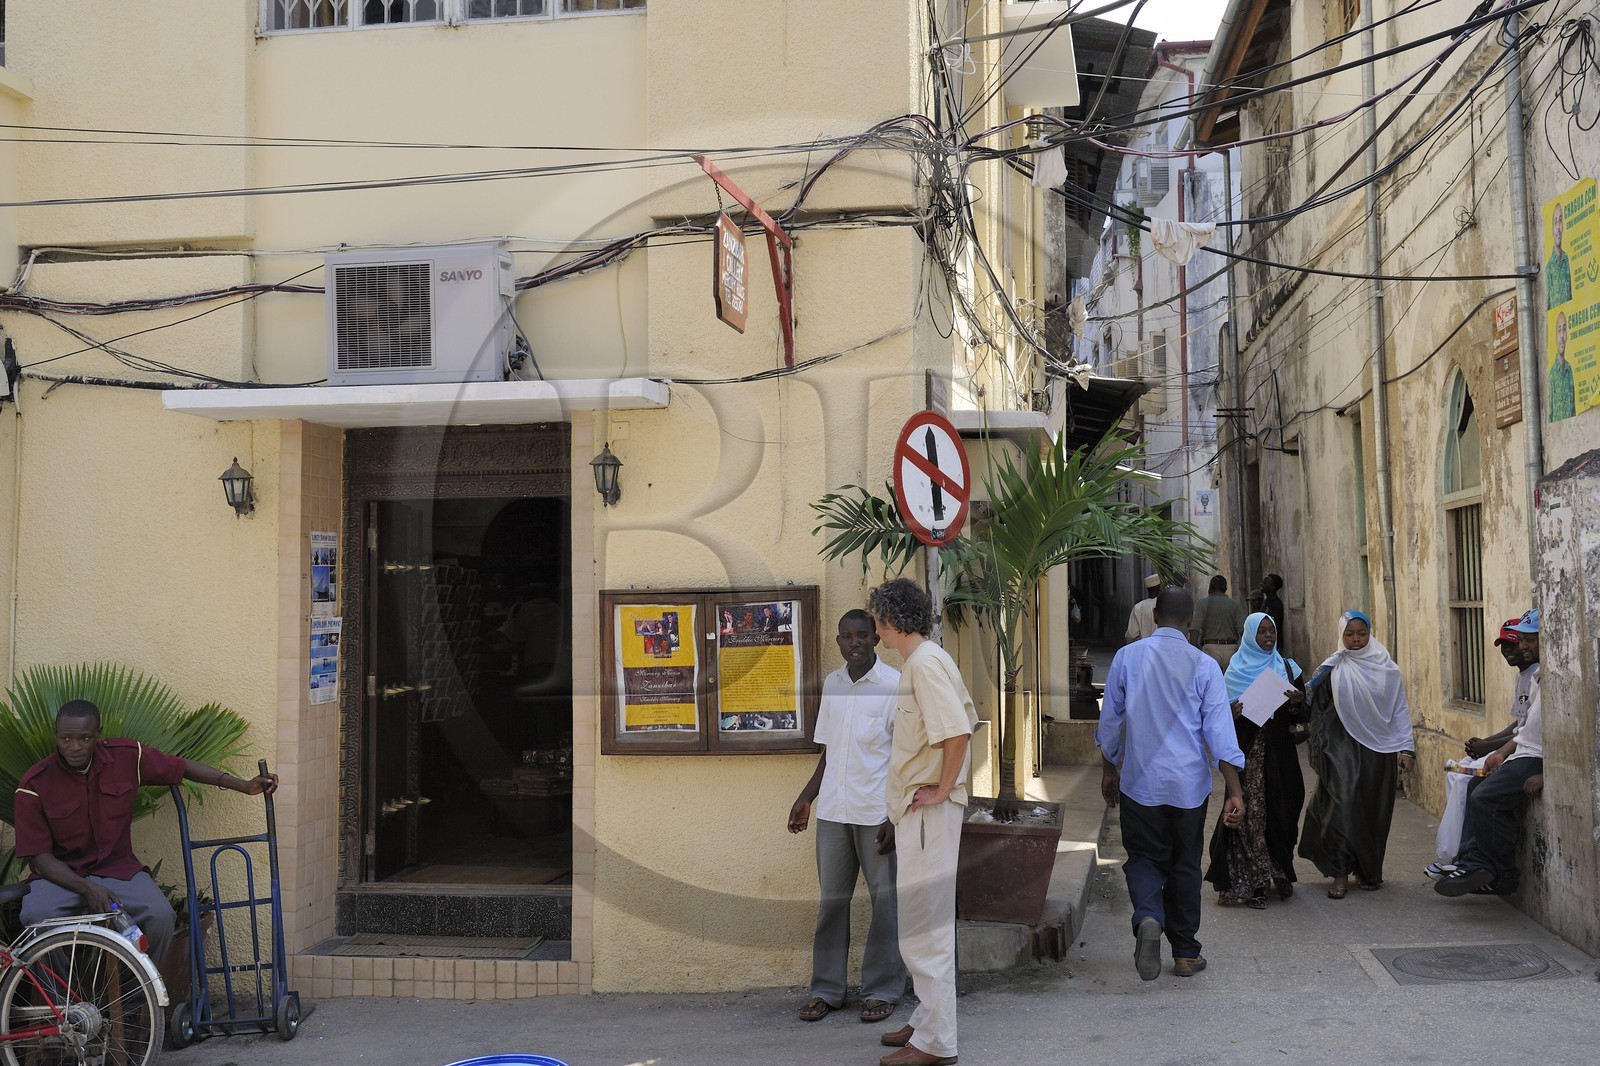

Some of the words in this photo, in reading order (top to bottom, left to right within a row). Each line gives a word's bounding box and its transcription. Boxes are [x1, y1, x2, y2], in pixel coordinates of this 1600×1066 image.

[1564, 194, 1584, 219] CHAGUA
[1585, 184, 1596, 205] CCM
[440, 269, 483, 282] SANYO
[1568, 308, 1588, 329] CHAGUA
[728, 635, 752, 644] Freddie
[754, 634, 784, 644] Mercury
[640, 680, 676, 691] Zanzibar
